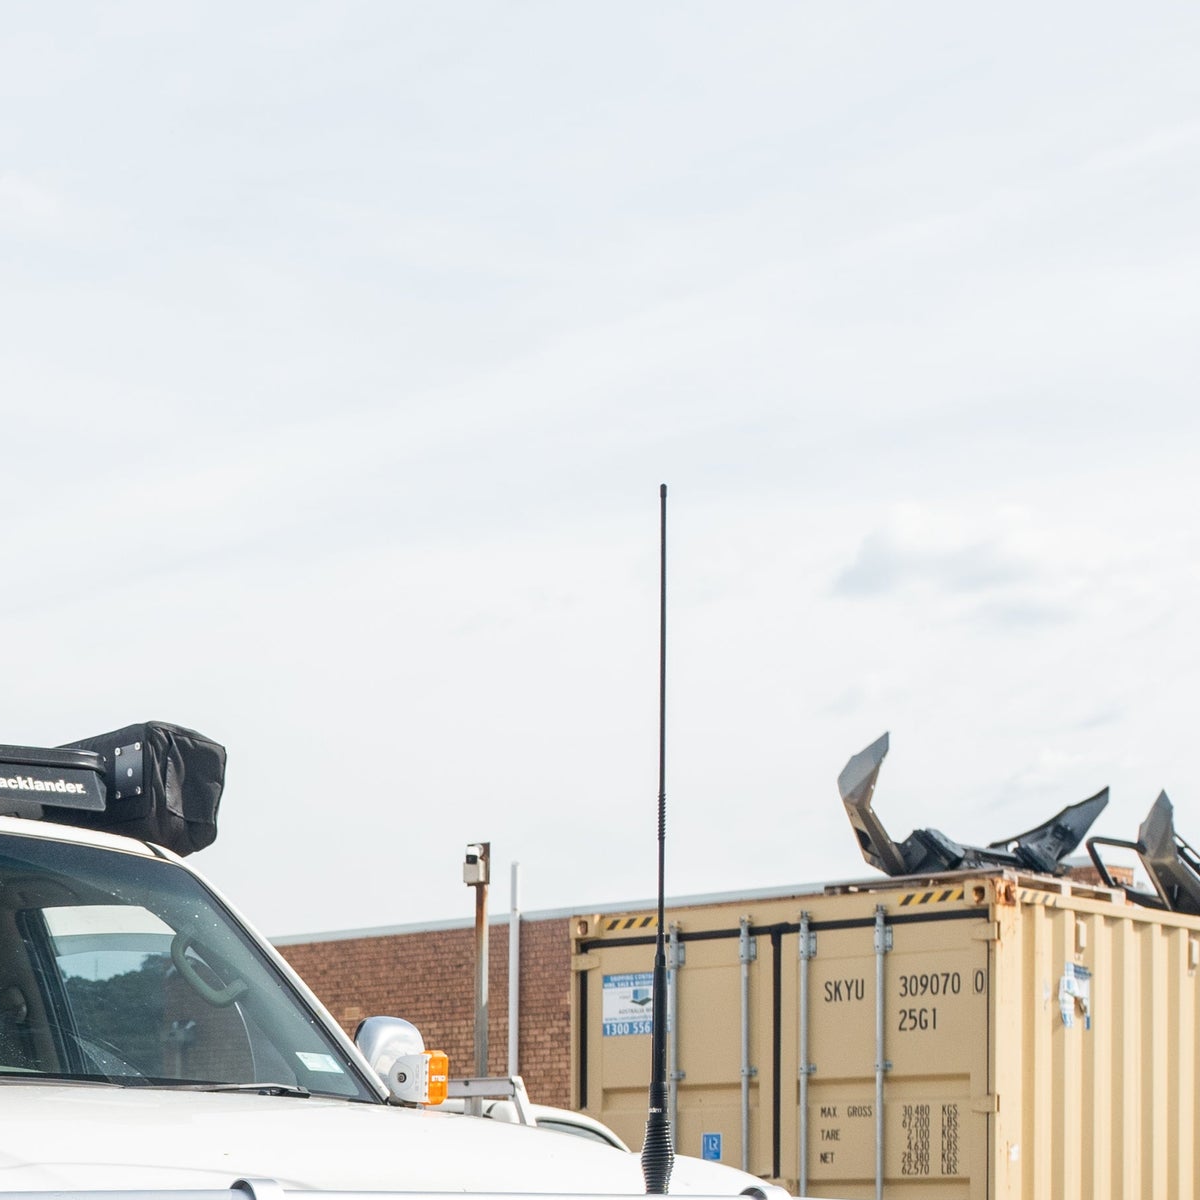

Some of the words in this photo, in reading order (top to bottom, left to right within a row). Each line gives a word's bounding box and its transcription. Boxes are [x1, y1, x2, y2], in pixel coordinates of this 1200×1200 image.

[824, 978, 865, 1002] SKYU
[899, 972, 961, 997] 309070
[974, 969, 985, 993] 0
[898, 1008, 937, 1031] 25G1
[606, 1022, 630, 1036] 1300
[633, 1021, 651, 1034] 556
[820, 1106, 837, 1118] MAX
[847, 1106, 873, 1118] GROSS
[902, 1103, 930, 1116] 30.480
[821, 1129, 841, 1141] TARE
[820, 1152, 835, 1164] NET
